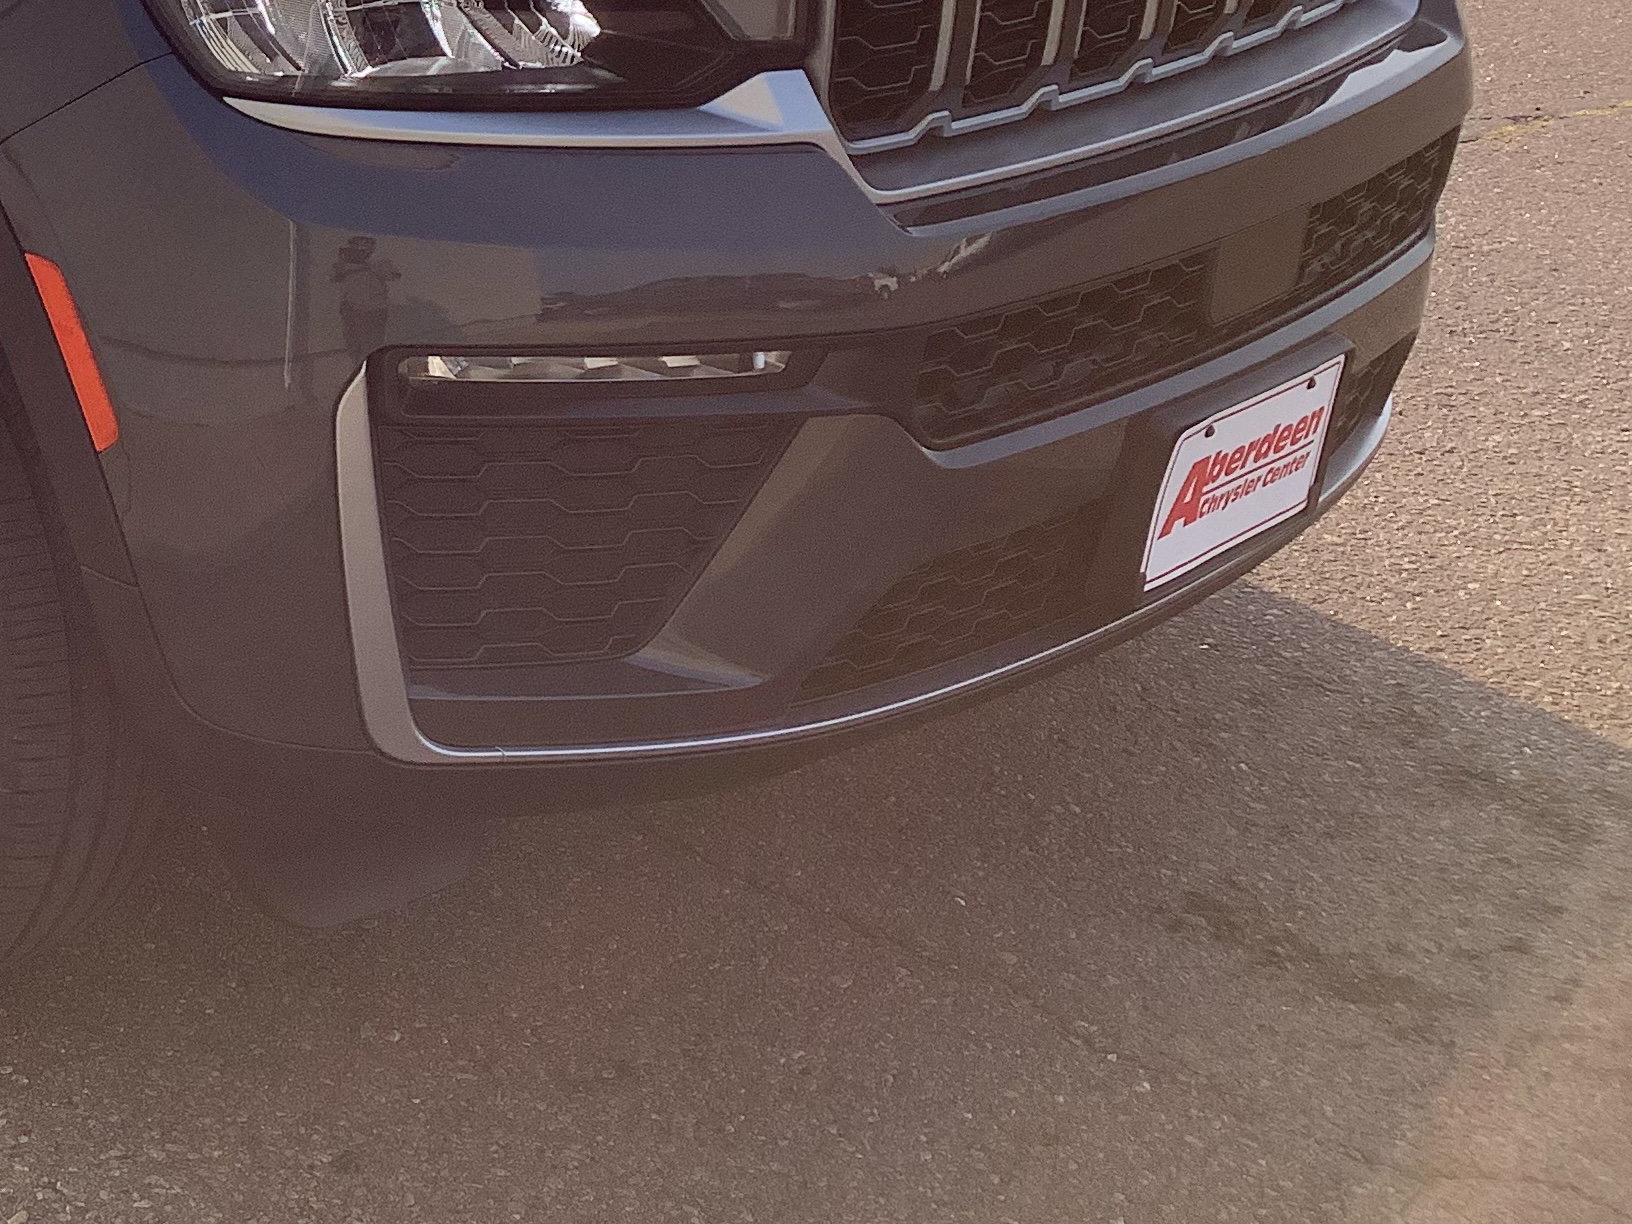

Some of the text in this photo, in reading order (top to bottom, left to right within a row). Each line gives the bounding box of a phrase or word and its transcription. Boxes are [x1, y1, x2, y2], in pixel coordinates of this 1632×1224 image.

[1157, 406, 1325, 540] Aberdeen
[1198, 450, 1312, 519] Chrysler Center
